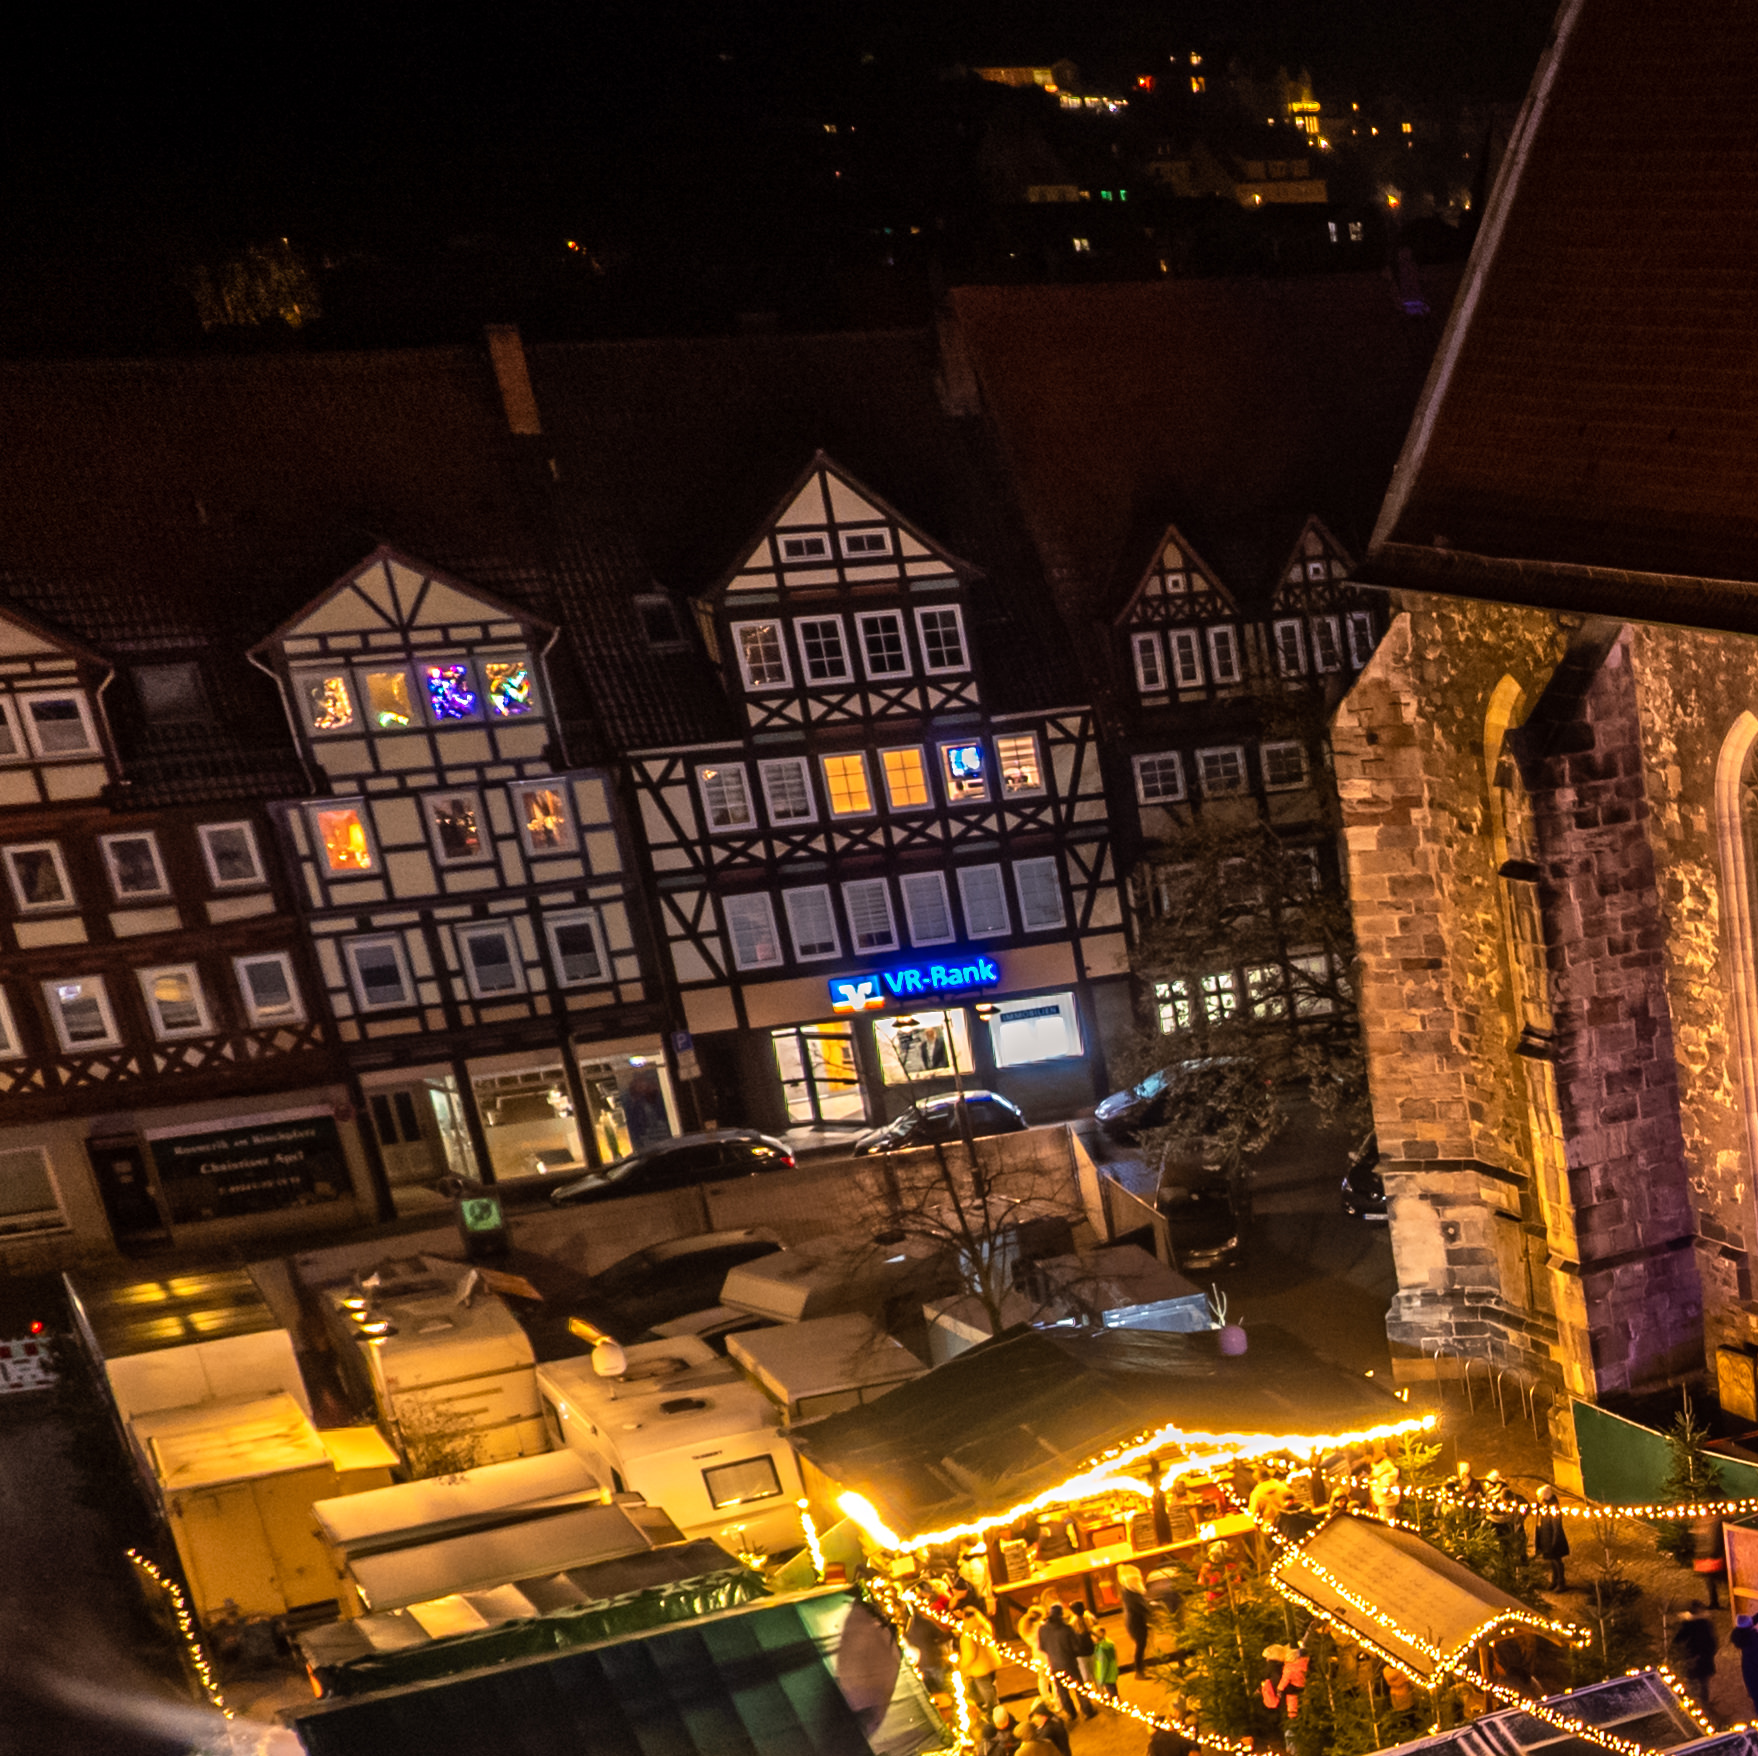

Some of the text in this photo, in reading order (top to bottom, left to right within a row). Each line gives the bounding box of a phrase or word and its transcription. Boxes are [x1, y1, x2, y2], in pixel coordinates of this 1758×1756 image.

[884, 958, 997, 994] VR-Bank
[1002, 1006, 1057, 1021] IMMOBILIEN
[676, 1033, 687, 1049] P
